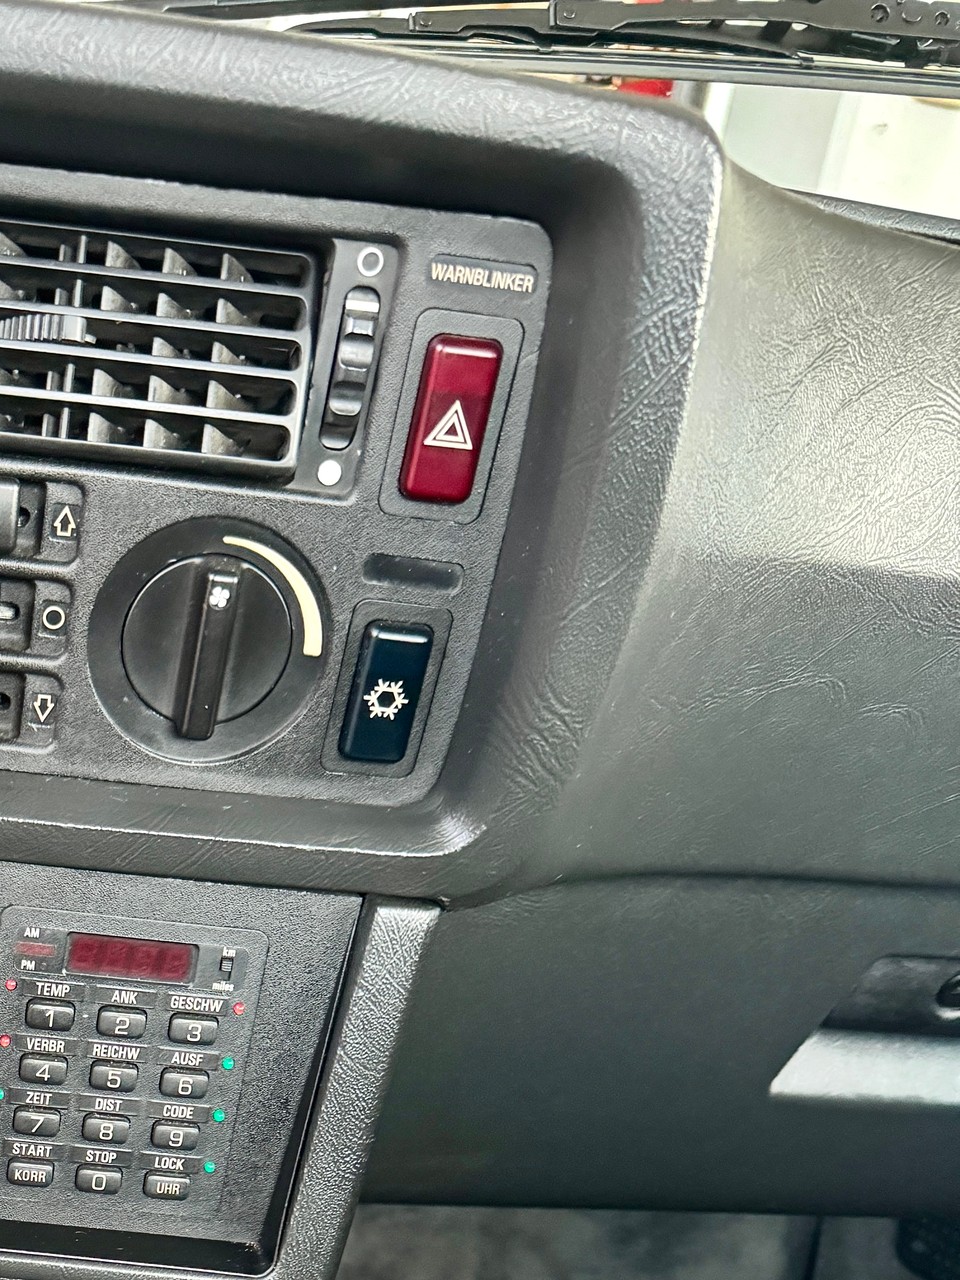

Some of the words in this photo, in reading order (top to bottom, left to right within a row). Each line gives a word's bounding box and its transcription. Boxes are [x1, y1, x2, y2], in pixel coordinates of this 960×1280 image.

[431, 262, 534, 293] WARNBLINKER
[24, 927, 40, 939] AM
[222, 946, 236, 958] km
[20, 960, 35, 971] PM
[36, 982, 70, 999] TEMP
[212, 981, 235, 992] miles
[111, 990, 138, 1005] ANK
[170, 996, 223, 1012] GESCHW
[45, 1010, 54, 1028] 1
[116, 1018, 130, 1035] 2
[187, 1024, 201, 1042] 3
[26, 1038, 65, 1053] VERBR
[92, 1044, 140, 1060] REICHW
[171, 1052, 203, 1067] AUSF
[36, 1065, 50, 1081] 4
[107, 1071, 121, 1089] 5
[178, 1078, 192, 1095] 6
[25, 1091, 52, 1105] ZEIT
[95, 1098, 122, 1111] DIST
[163, 1105, 193, 1119] CODE
[31, 1116, 44, 1132] 7
[100, 1123, 114, 1140] 8
[169, 1130, 183, 1147] 9
[12, 1143, 52, 1158] START
[85, 1150, 116, 1164] STOP
[154, 1157, 185, 1170] LOCK
[14, 1169, 46, 1183] KORR
[92, 1174, 106, 1191] 0
[157, 1182, 180, 1195] UHR
